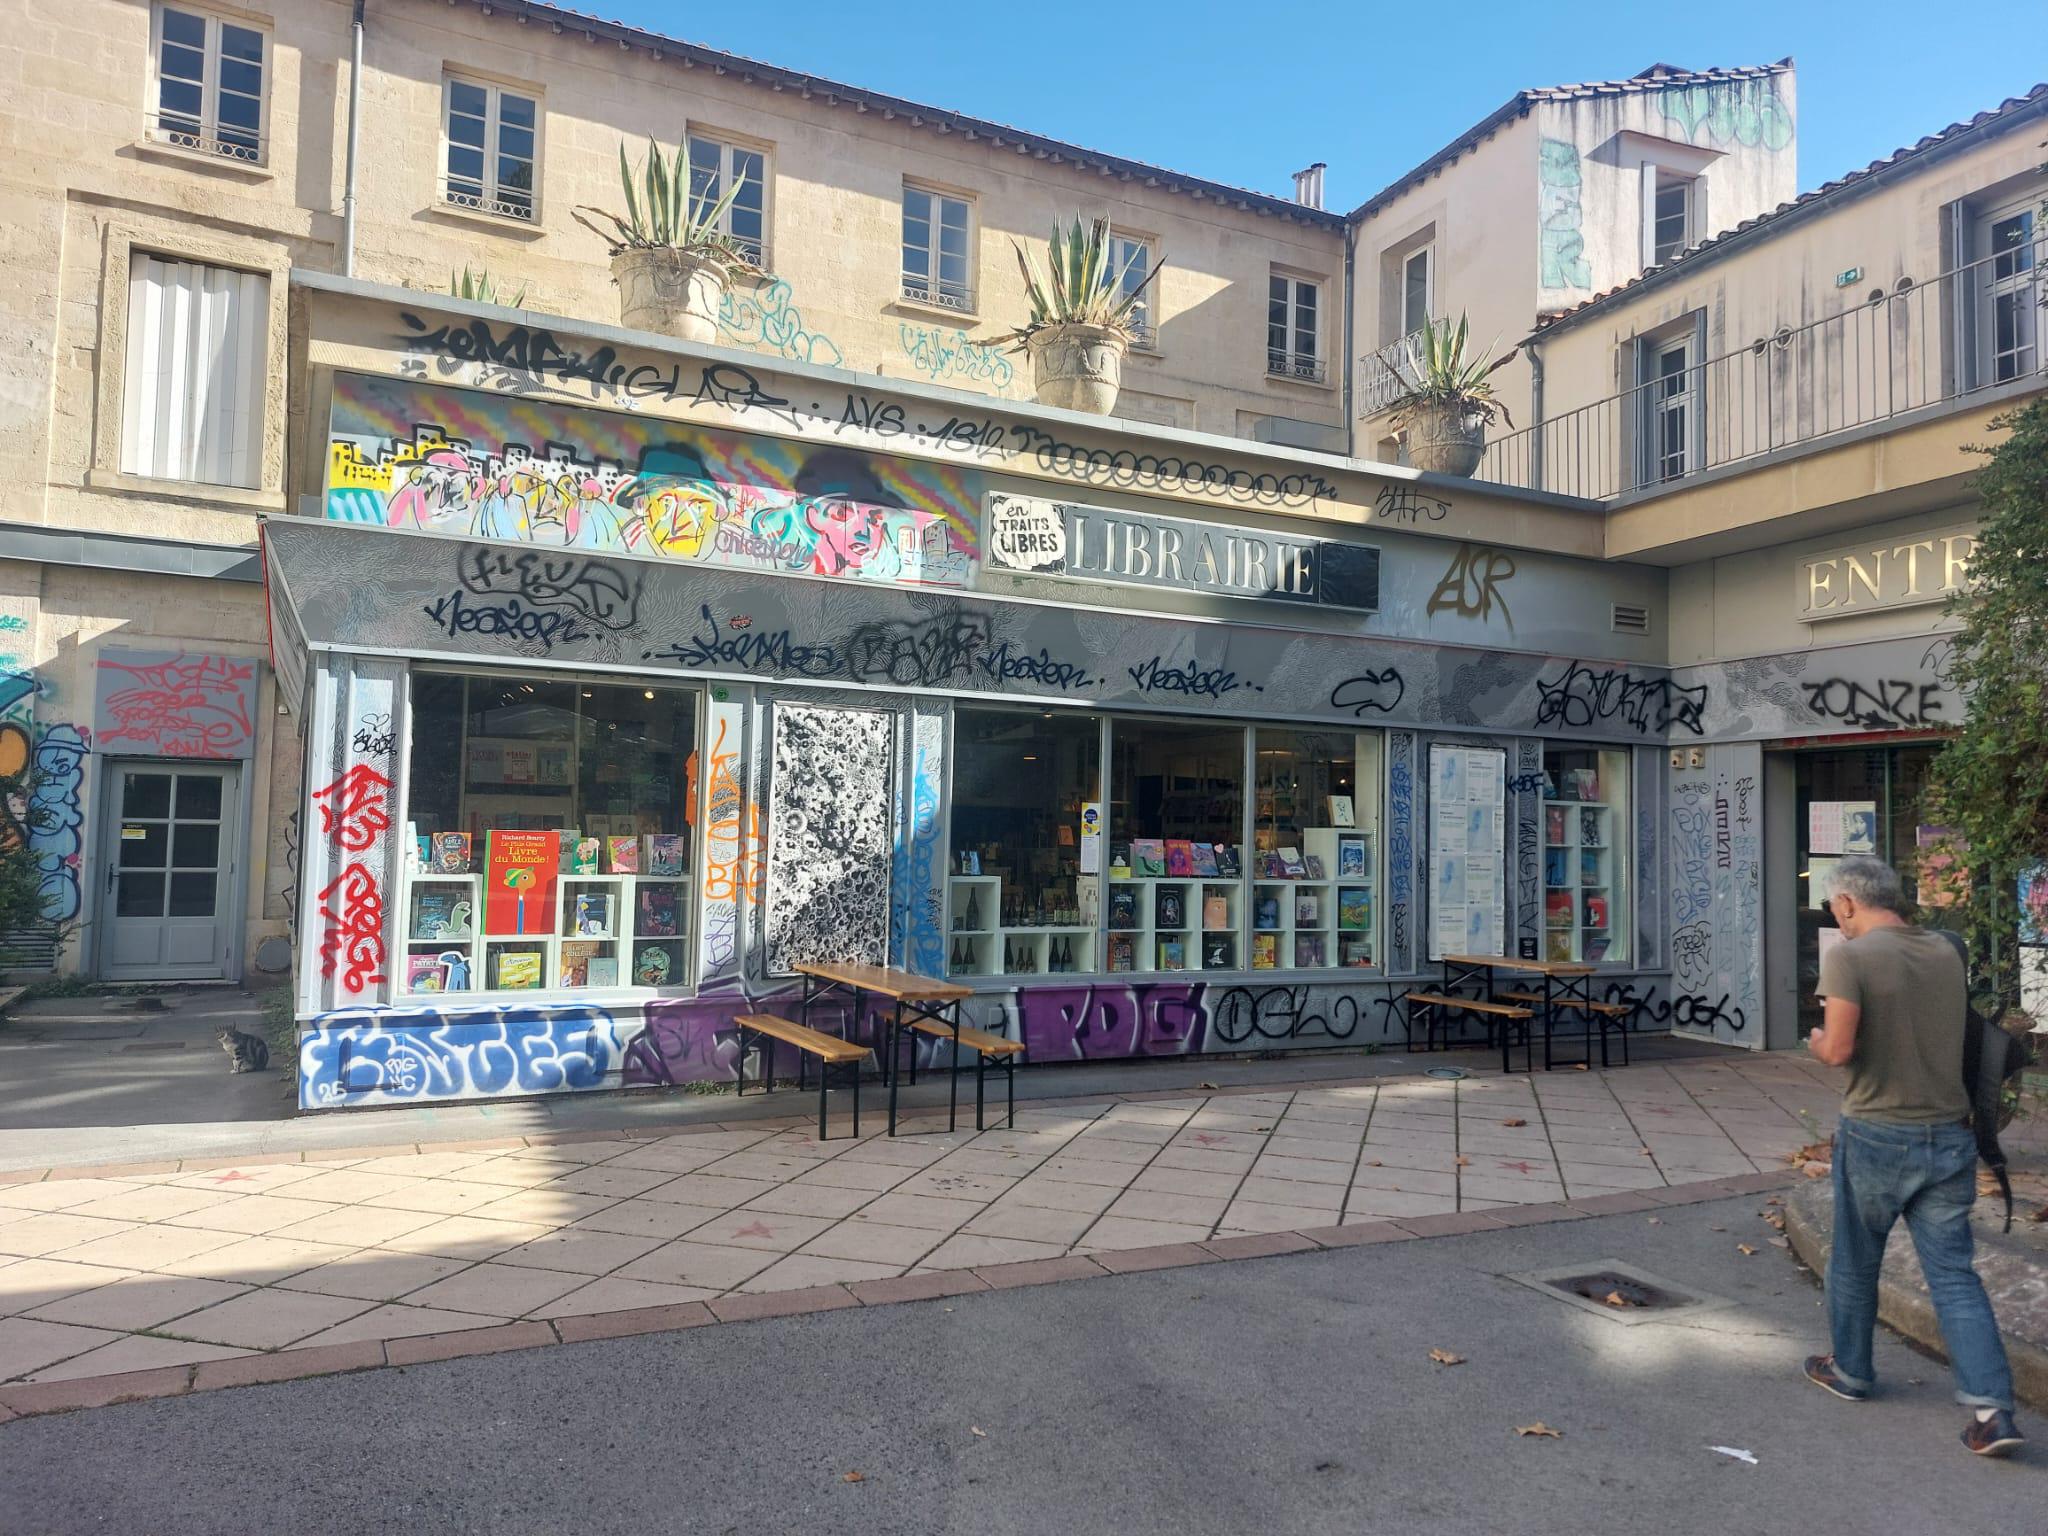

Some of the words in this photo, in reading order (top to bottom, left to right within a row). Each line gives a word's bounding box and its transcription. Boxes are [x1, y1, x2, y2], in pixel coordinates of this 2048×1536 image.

[1007, 503, 1029, 517] en
[999, 518, 1050, 531] TRAITS
[1000, 533, 1058, 553] LIBRES
[1071, 514, 1318, 597] LIBRAIRIE
[1802, 534, 1989, 612] ENTR
[508, 846, 538, 856] Livre
[495, 855, 508, 863] du
